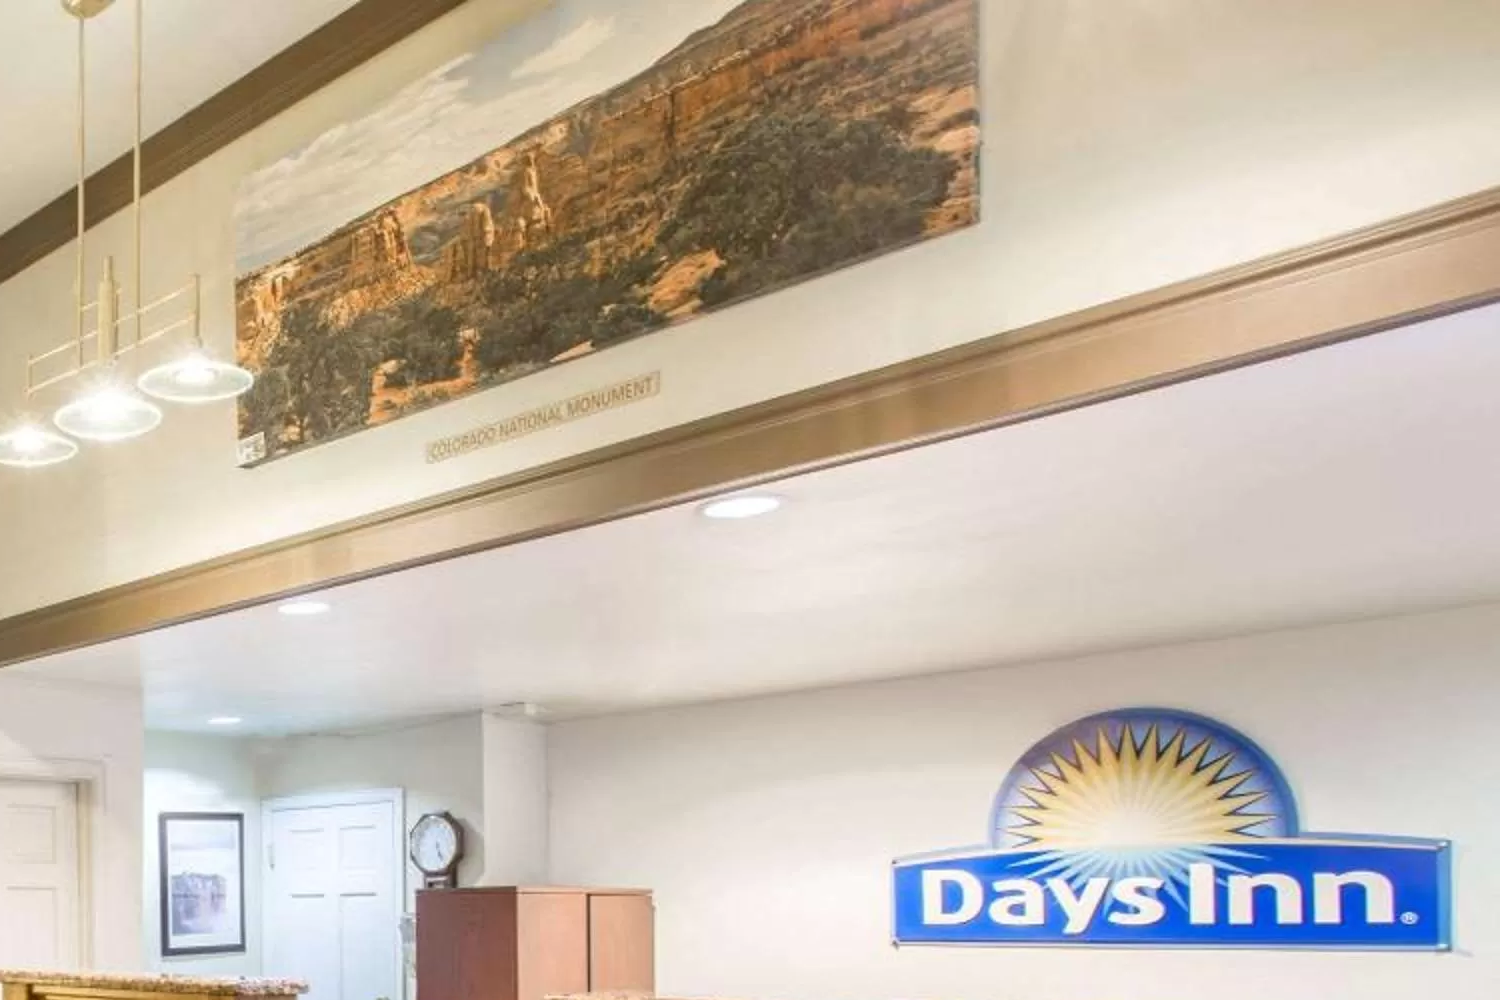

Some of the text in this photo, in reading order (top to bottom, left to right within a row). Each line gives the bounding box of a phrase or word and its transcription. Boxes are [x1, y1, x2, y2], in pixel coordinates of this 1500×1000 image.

[430, 376, 654, 460] COLORADO NATIONAL MONUMENT
[921, 863, 1396, 935] Days Inn
